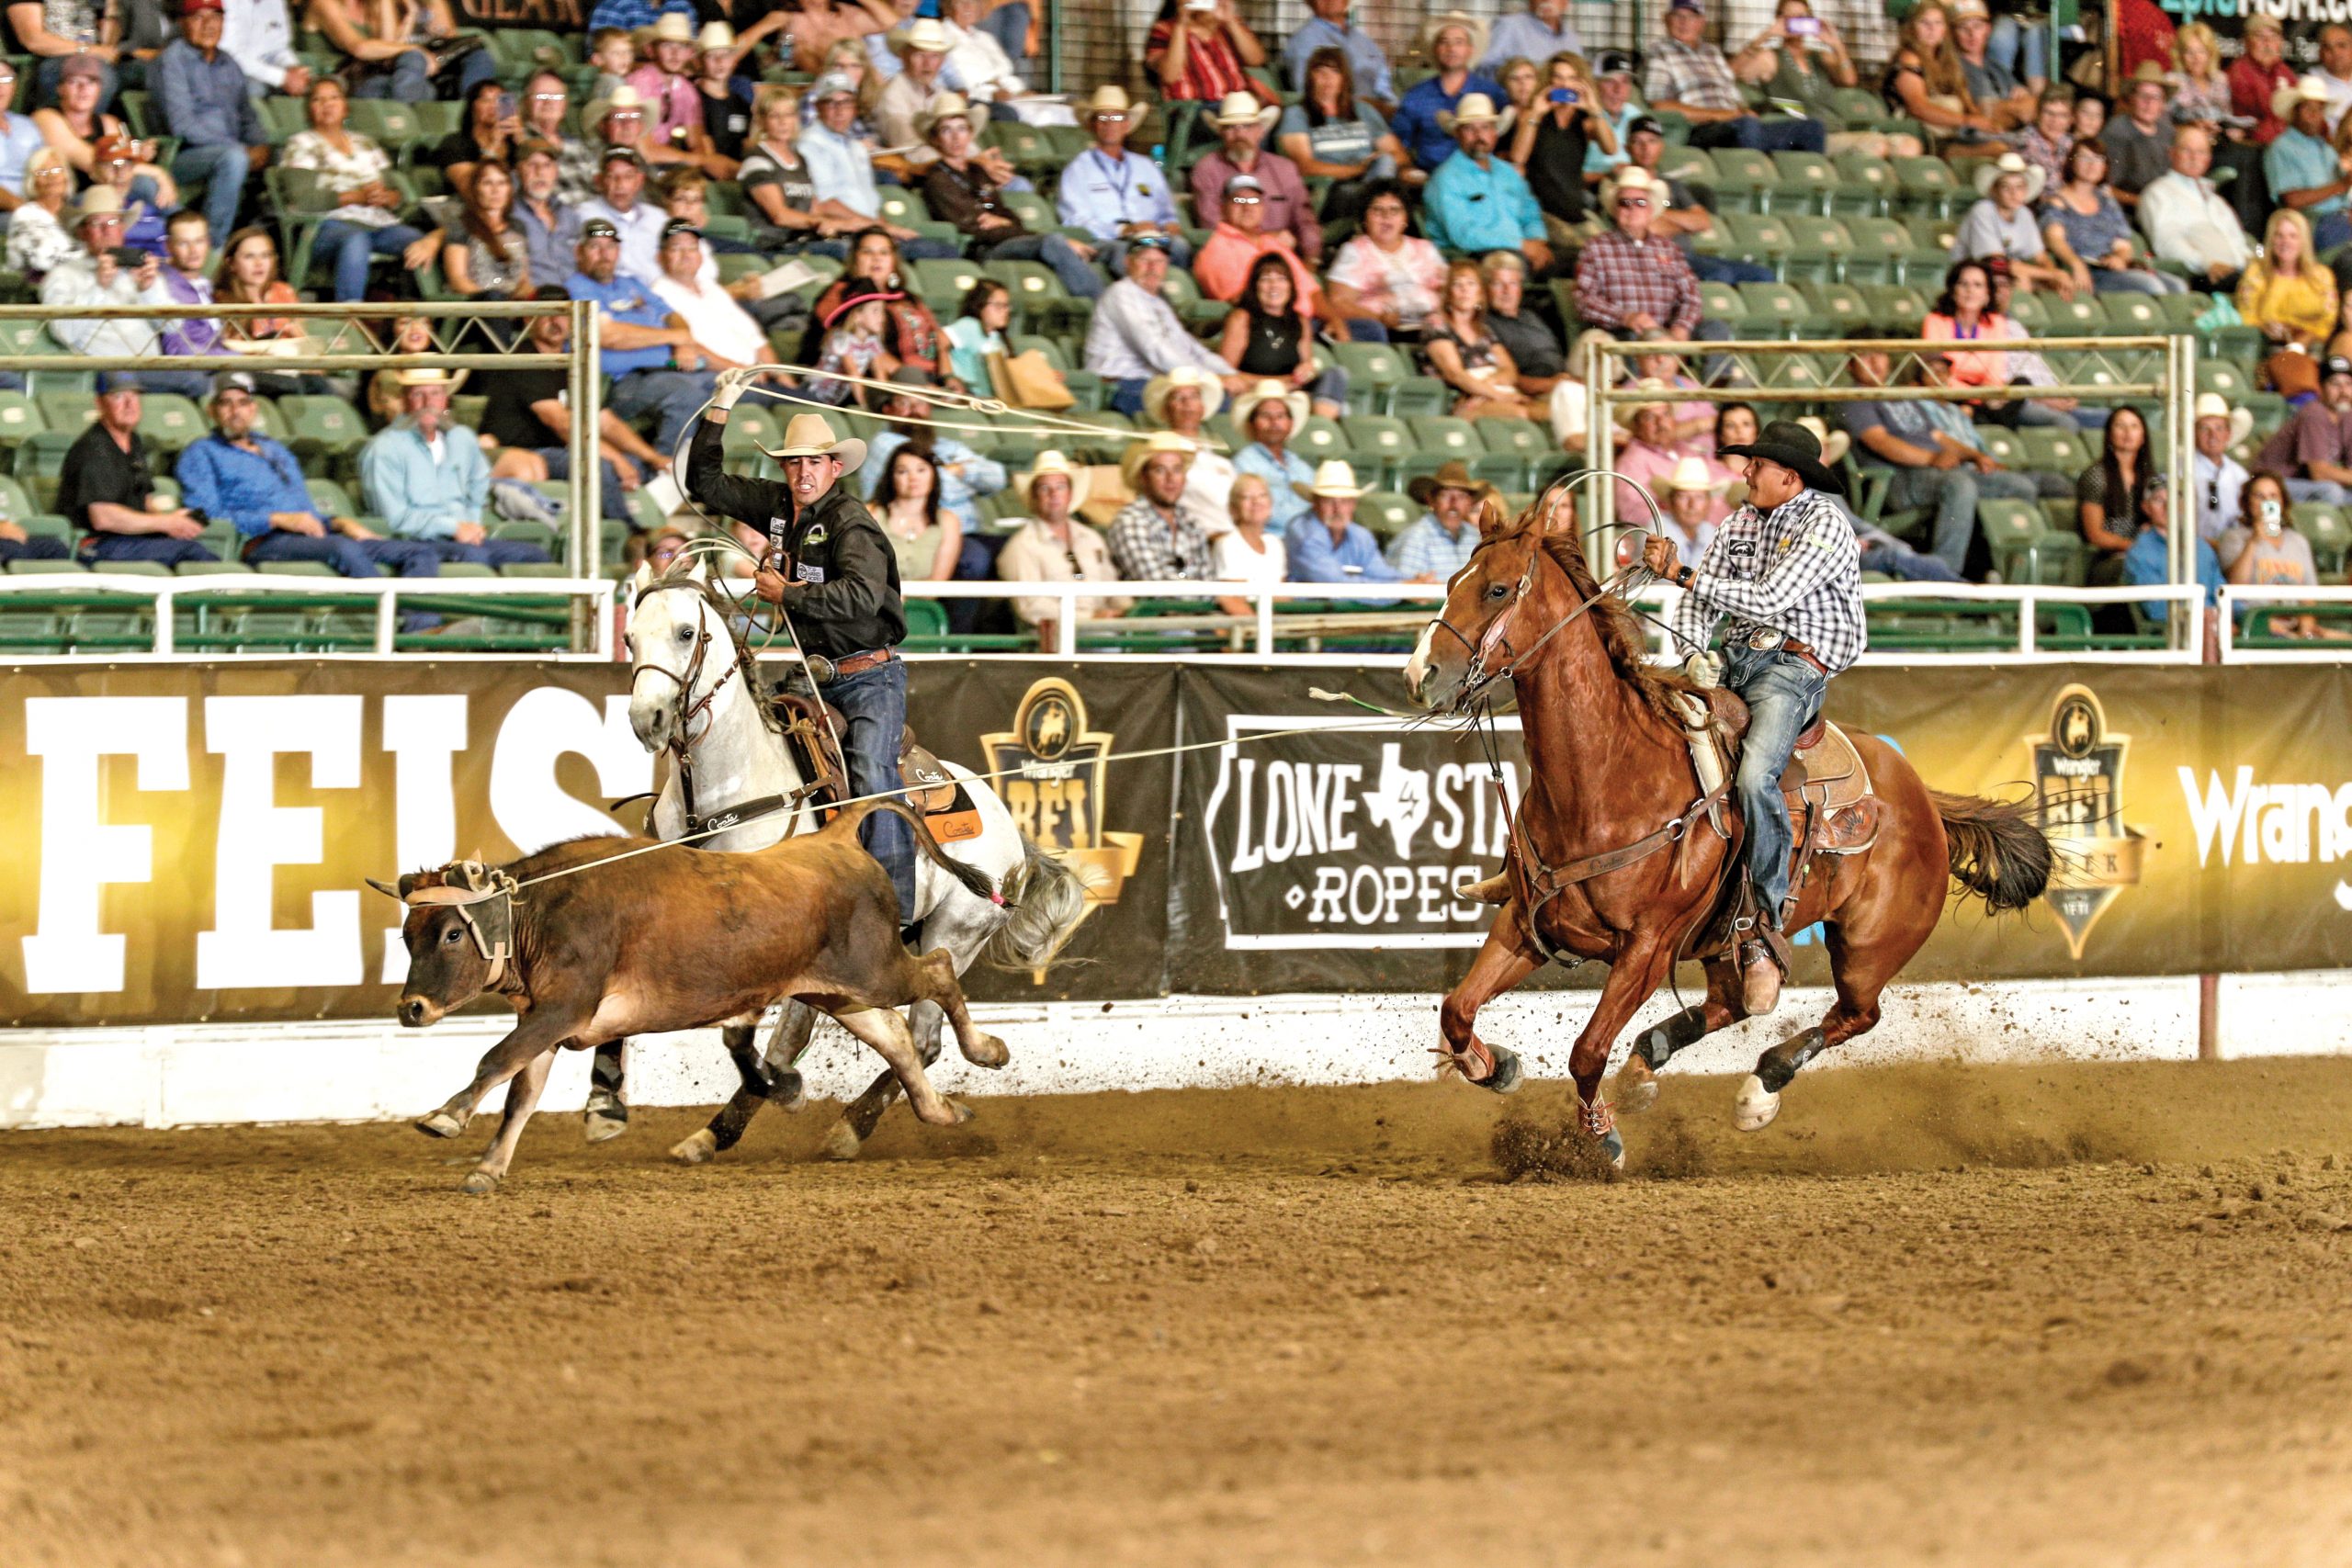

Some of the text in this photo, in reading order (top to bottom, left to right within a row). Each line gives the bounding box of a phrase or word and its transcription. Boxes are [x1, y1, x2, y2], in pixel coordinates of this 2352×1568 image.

[2052, 756, 2102, 783] Wrangler
[1231, 758, 1363, 873] LONE
[1307, 864, 1483, 925] ROPES
[2063, 901, 2089, 917] YETI
